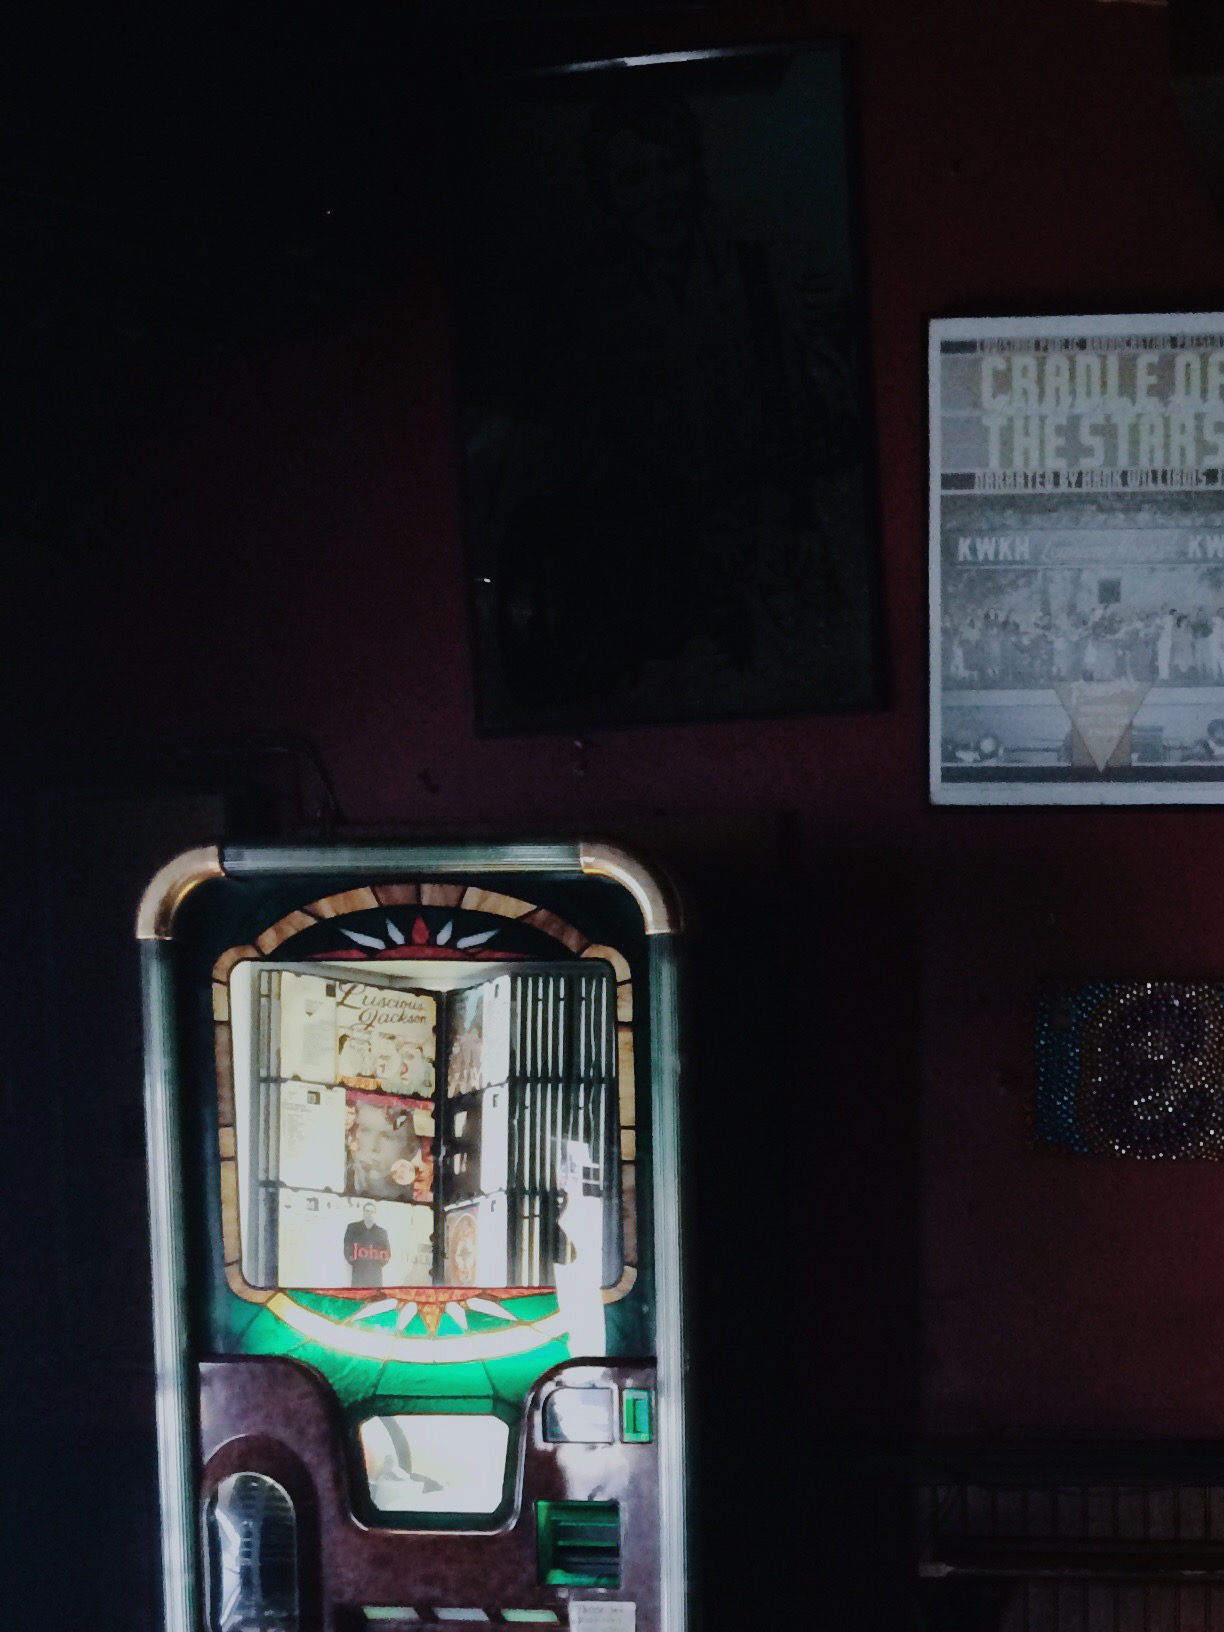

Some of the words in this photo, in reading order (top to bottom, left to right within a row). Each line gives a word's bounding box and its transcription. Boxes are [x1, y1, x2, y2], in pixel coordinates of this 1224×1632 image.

[980, 352, 1160, 409] CRADLE
[981, 409, 1068, 470] THE
[958, 536, 1030, 562] KWKH
[336, 983, 424, 1012] Luscious
[358, 1008, 427, 1031] Jackson
